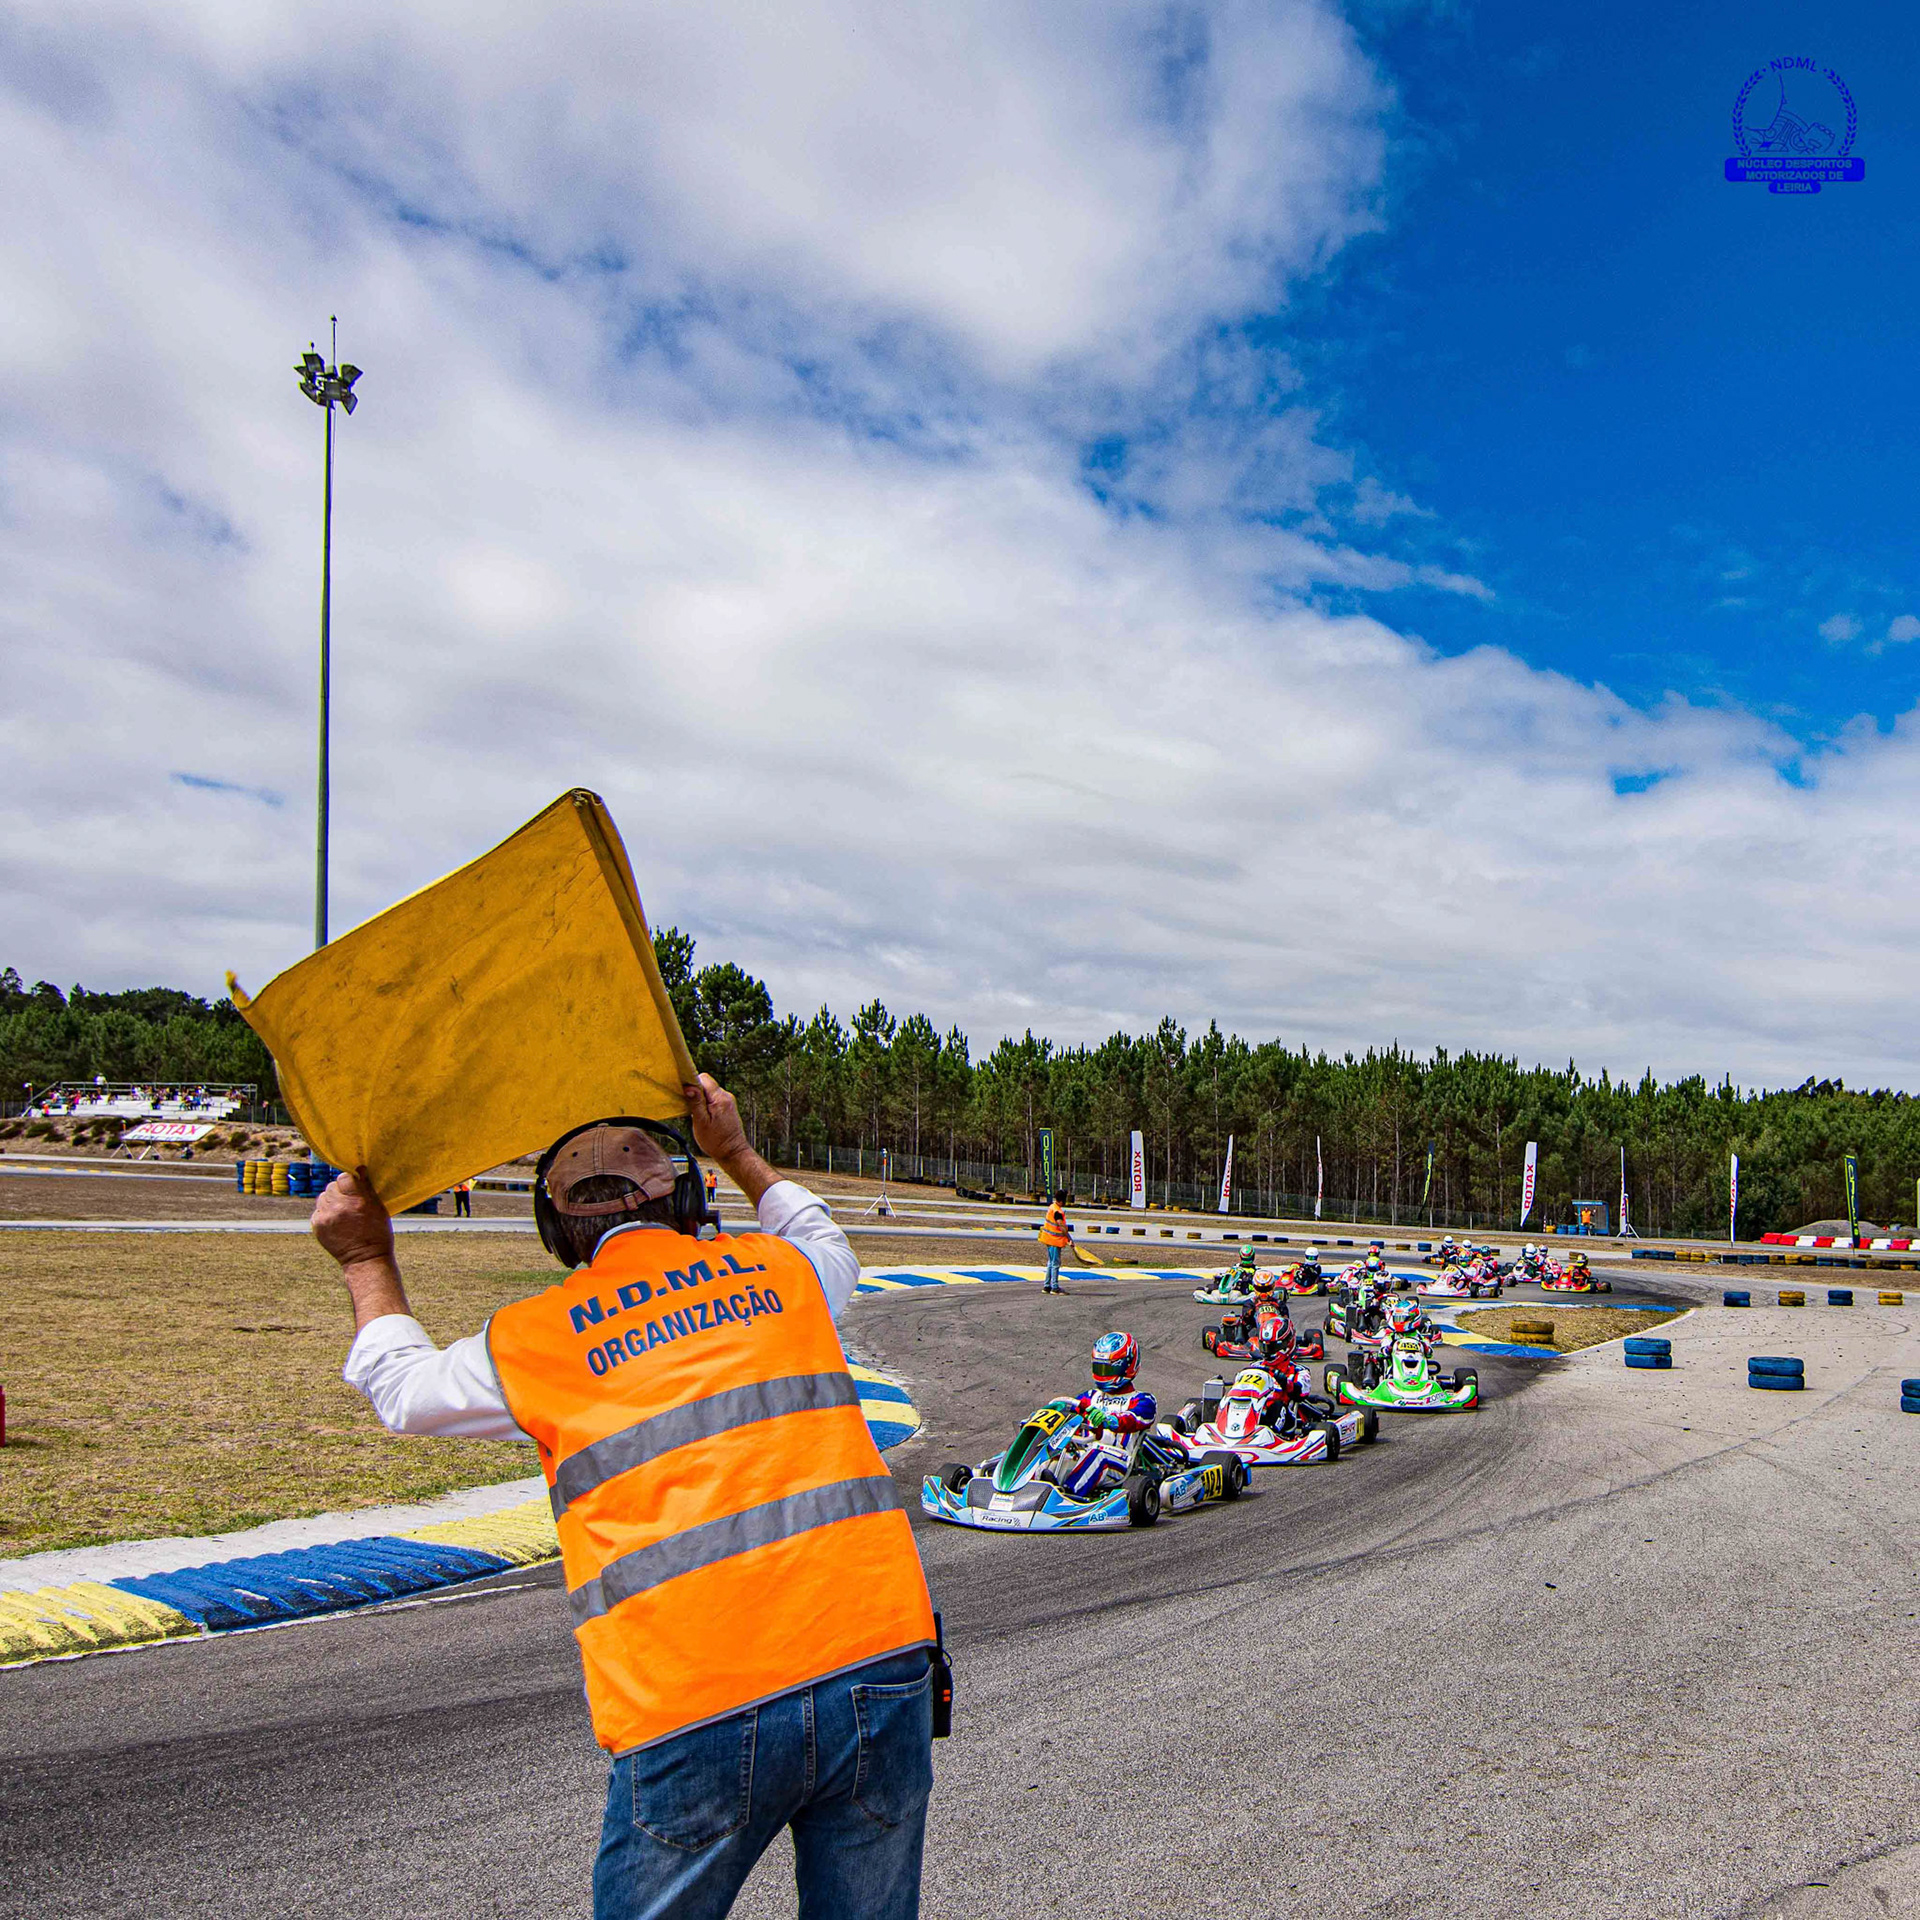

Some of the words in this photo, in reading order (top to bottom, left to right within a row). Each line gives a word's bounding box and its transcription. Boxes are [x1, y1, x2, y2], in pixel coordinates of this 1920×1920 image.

[138, 1122, 202, 1136] ROTAX
[1524, 1164, 1534, 1209] ROTAX
[569, 1253, 767, 1334] N.D.M.L.
[587, 1284, 784, 1377] ORGANIZAÇÃO
[982, 1515, 1013, 1524] Racing
